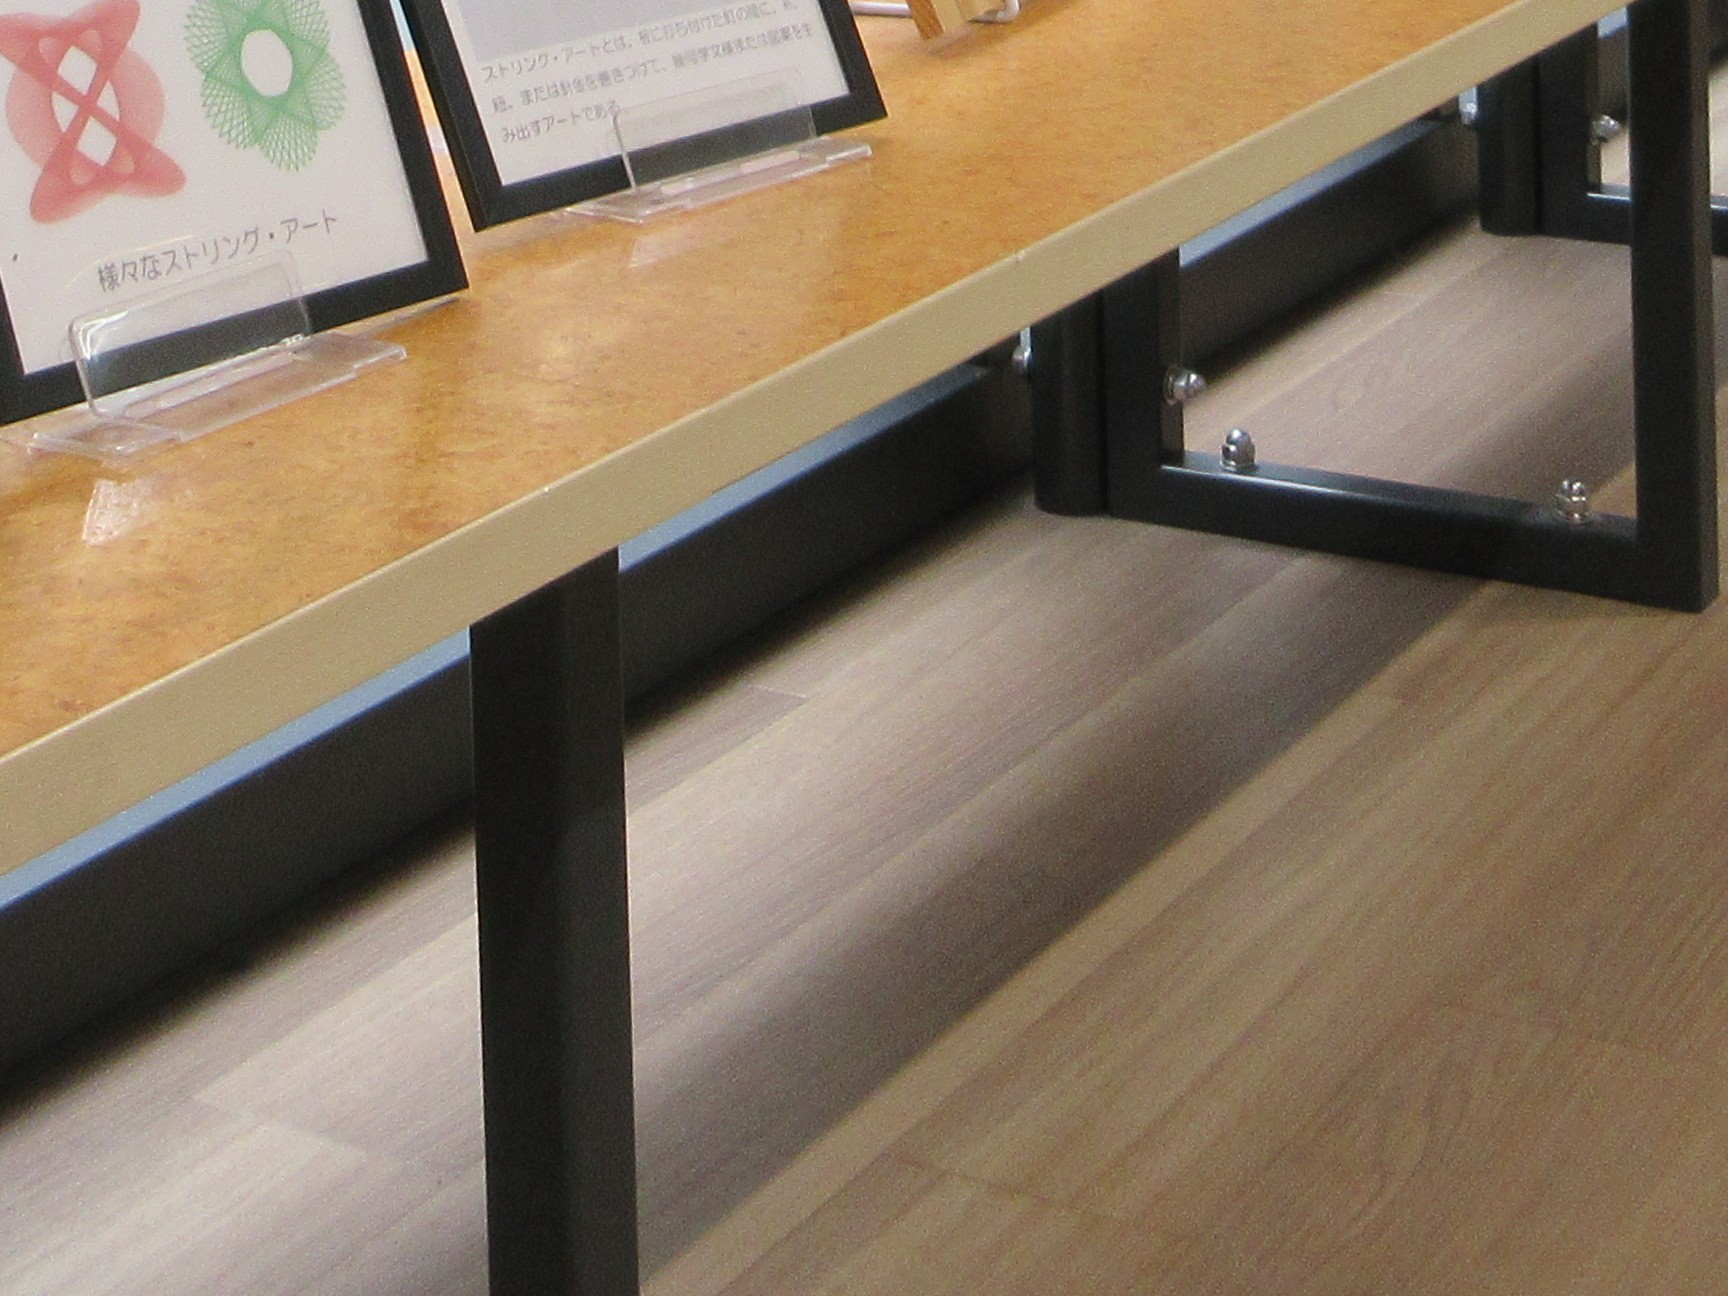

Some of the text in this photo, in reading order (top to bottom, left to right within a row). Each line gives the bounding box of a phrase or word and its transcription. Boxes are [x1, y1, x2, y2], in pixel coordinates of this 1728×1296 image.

[97, 209, 338, 292] 様々なストリング・アート
